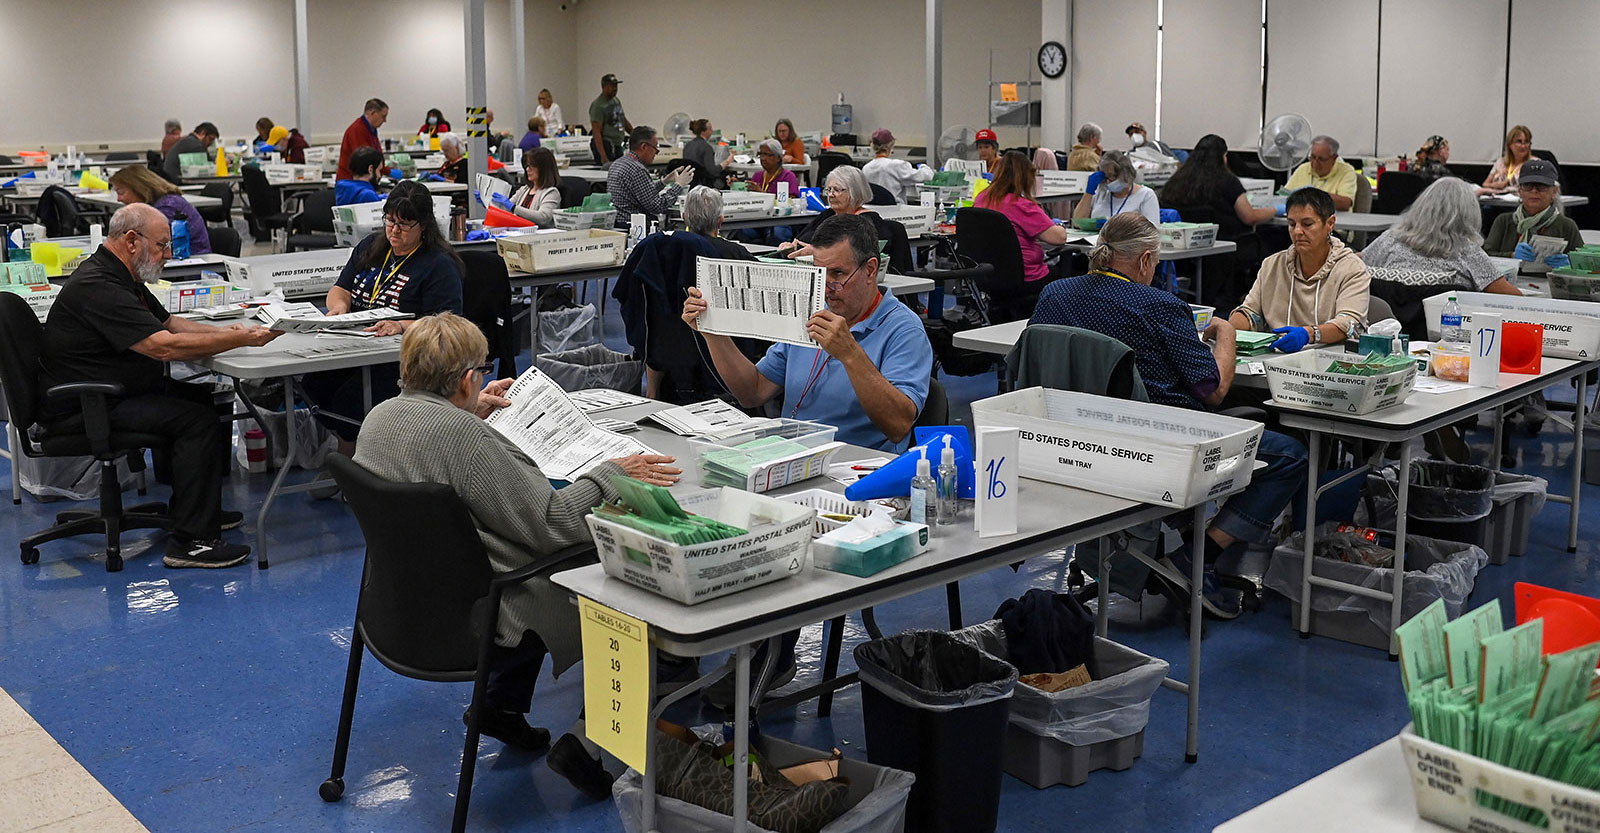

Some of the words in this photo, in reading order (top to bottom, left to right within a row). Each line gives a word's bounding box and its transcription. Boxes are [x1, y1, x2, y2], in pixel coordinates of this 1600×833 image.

[272, 269, 293, 277] UNITED
[1477, 328, 1496, 357] 17
[1267, 365, 1288, 375] UNITED
[1288, 369, 1311, 379] STATES
[1312, 373, 1336, 383] POSTAL
[1337, 376, 1366, 386] SERVICE
[1303, 380, 1325, 388] WARNING
[1018, 430, 1034, 441] TED
[1035, 433, 1070, 448] STATES
[1071, 440, 1108, 455] POSTAL
[1111, 447, 1154, 463] SERVICE
[1205, 447, 1222, 457] LABEL
[1058, 457, 1074, 466] EMM
[1075, 459, 1093, 469] TRAY
[1203, 454, 1221, 465] OTHER
[1204, 463, 1216, 472] END
[985, 457, 1006, 500] 16
[593, 523, 613, 537] LABEL
[595, 532, 616, 545] OTHER
[684, 546, 719, 559] UNITED
[720, 539, 752, 554] STATES
[754, 529, 784, 545] POSTAL
[785, 516, 813, 535] SERVICE
[647, 542, 669, 555] LABEL
[739, 546, 768, 558] WARNING
[650, 552, 673, 565] OTHER
[695, 587, 711, 597] HALF
[711, 584, 723, 592] MM
[723, 579, 740, 588] TRAY
[593, 611, 614, 626] TABLES
[614, 620, 631, 633] 16-20
[609, 637, 619, 652] 20
[610, 658, 620, 672] 19
[611, 678, 621, 692] 18
[612, 699, 621, 712] 17
[611, 719, 620, 734] 16
[1416, 749, 1460, 773] LABEL
[1417, 760, 1464, 786] OTHER
[1428, 777, 1456, 796] END
